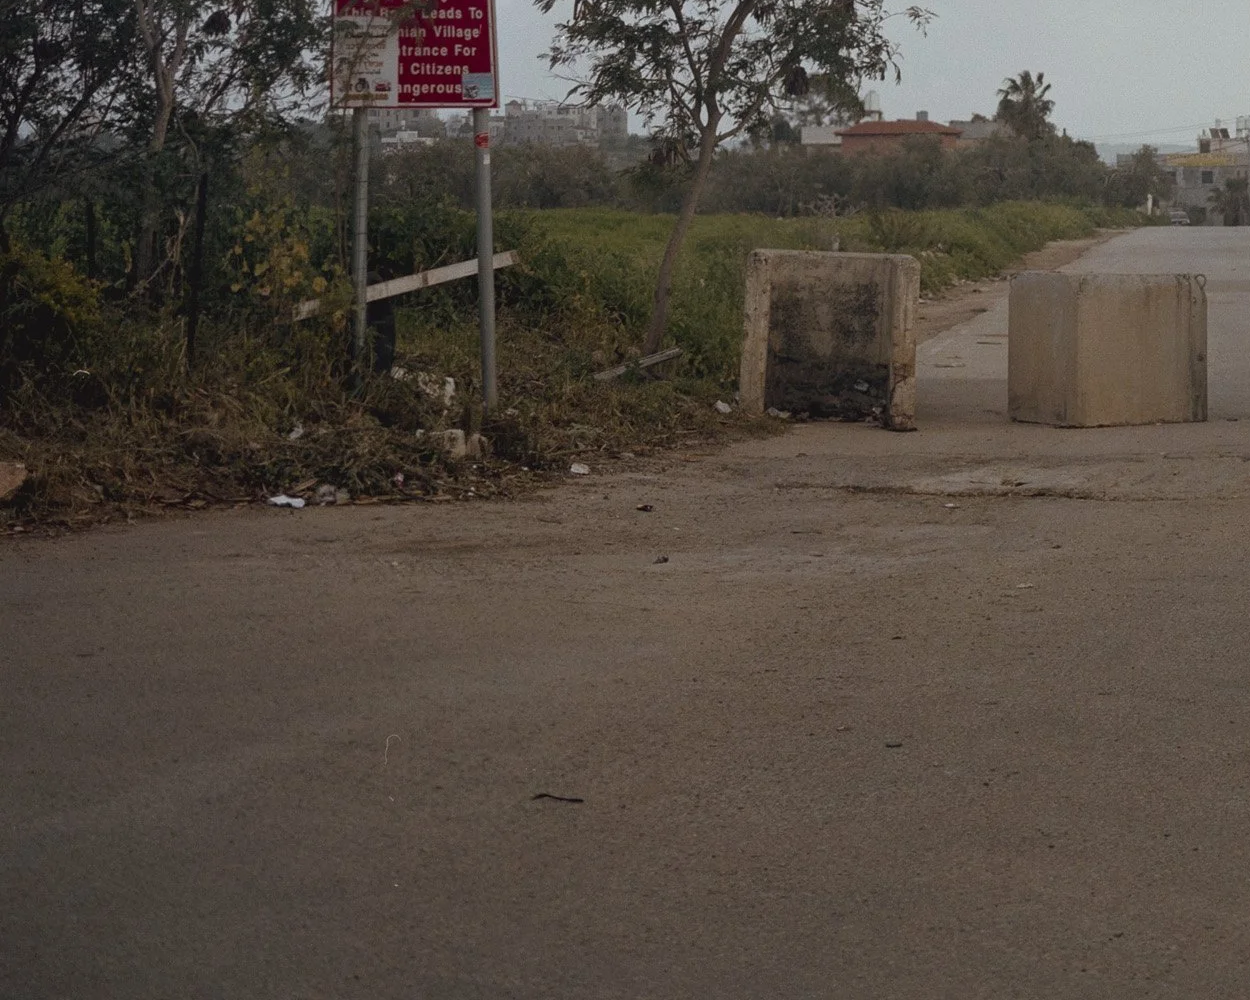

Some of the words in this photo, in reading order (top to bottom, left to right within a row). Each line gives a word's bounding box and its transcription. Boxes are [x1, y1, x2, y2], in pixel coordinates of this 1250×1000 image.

[468, 7, 483, 19] To
[433, 25, 480, 40] Village
[398, 45, 448, 57] trance
[454, 45, 477, 57] For
[410, 63, 470, 75] Citizens
